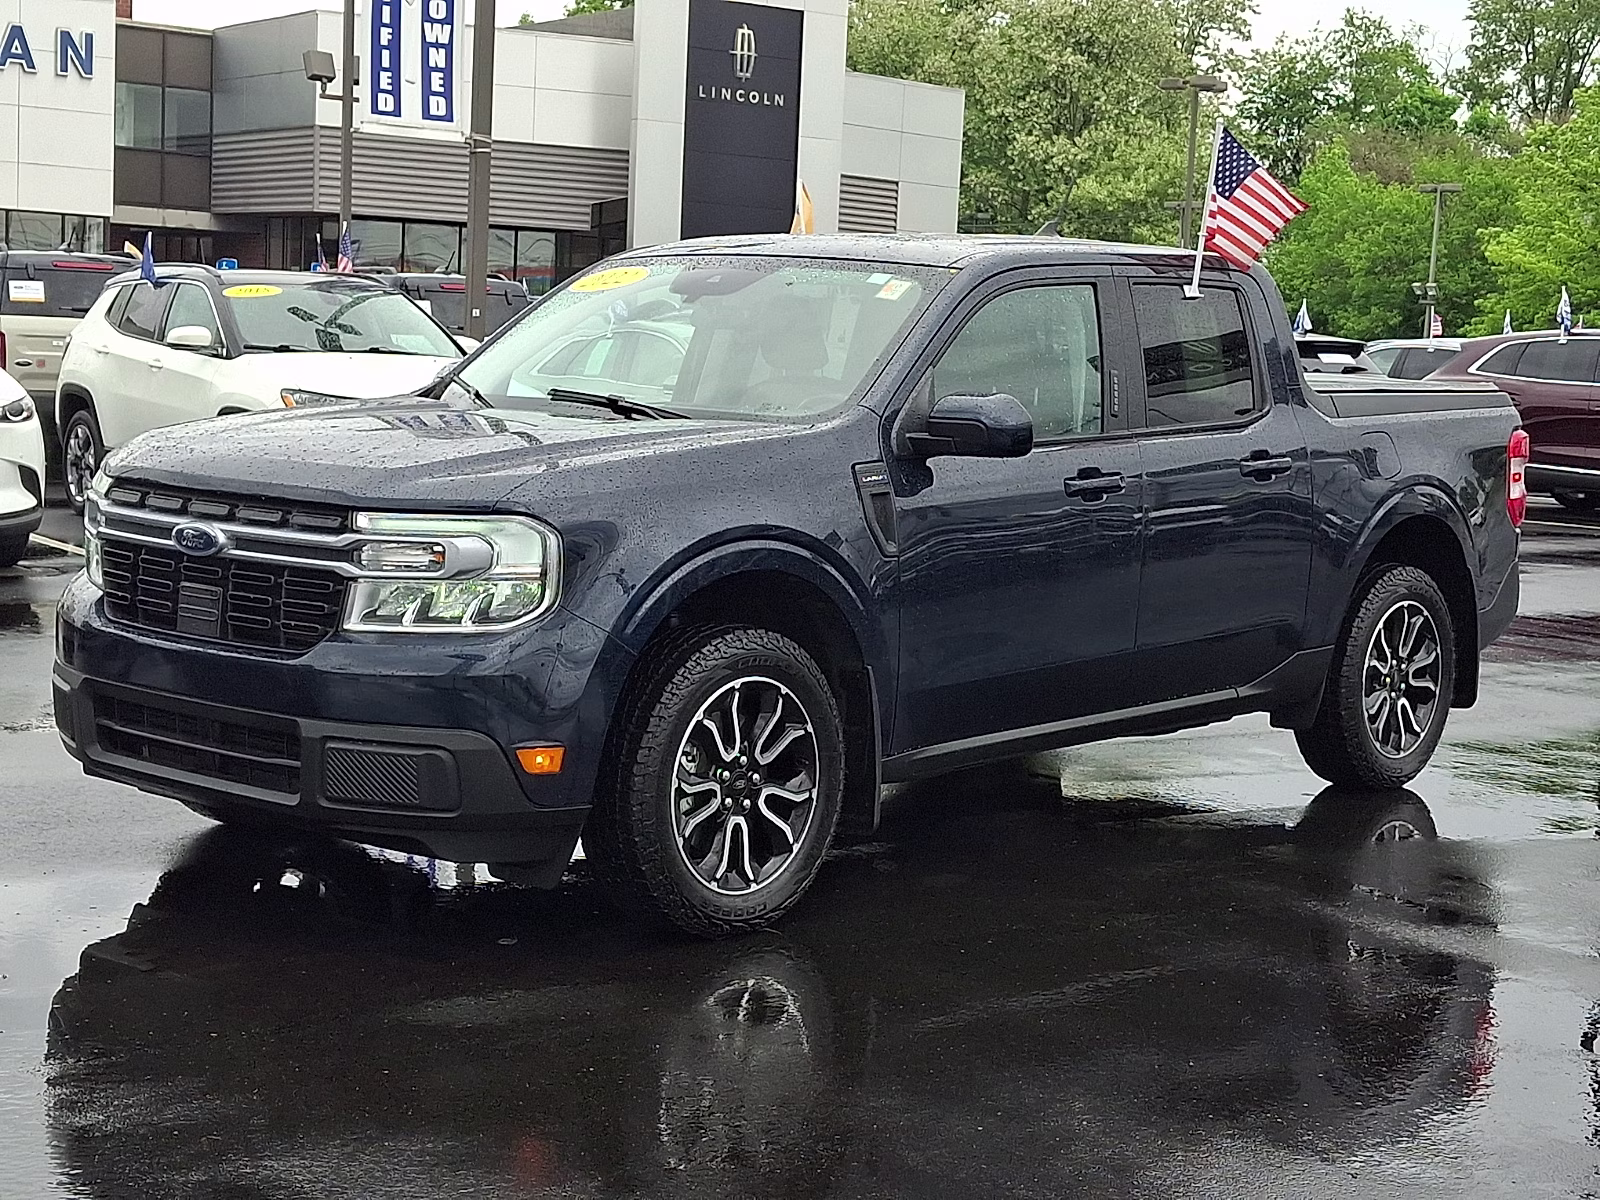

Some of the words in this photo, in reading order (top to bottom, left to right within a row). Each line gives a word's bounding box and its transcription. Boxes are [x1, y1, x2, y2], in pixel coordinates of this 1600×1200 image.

[377, 0, 395, 112] IFIED
[423, 0, 452, 117] OWNED
[698, 84, 785, 107] LINCOLN
[180, 528, 207, 549] Ford
